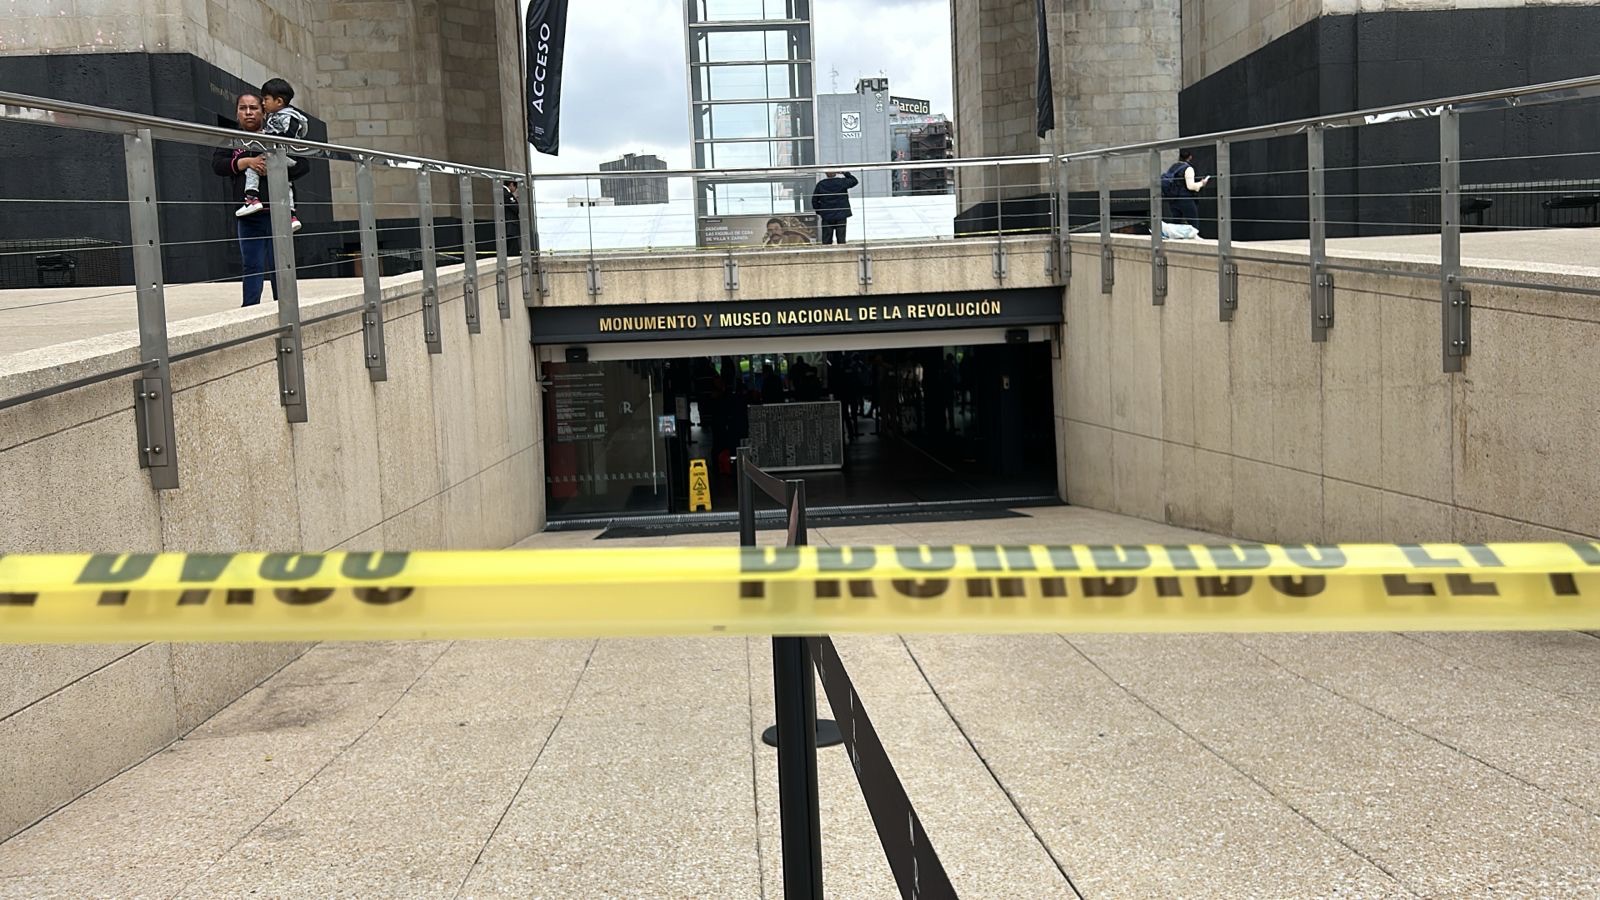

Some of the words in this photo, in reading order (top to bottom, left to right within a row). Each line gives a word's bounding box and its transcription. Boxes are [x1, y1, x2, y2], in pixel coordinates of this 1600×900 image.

[532, 22, 551, 115] ACCESO
[600, 315, 697, 332] MONUMENTO
[703, 314, 713, 328] Y
[720, 312, 771, 327] MUSEO
[777, 308, 853, 325] NACIONAL
[859, 307, 877, 321] DE
[883, 306, 902, 320] LA
[907, 299, 1001, 319] REVOLUCIÓN
